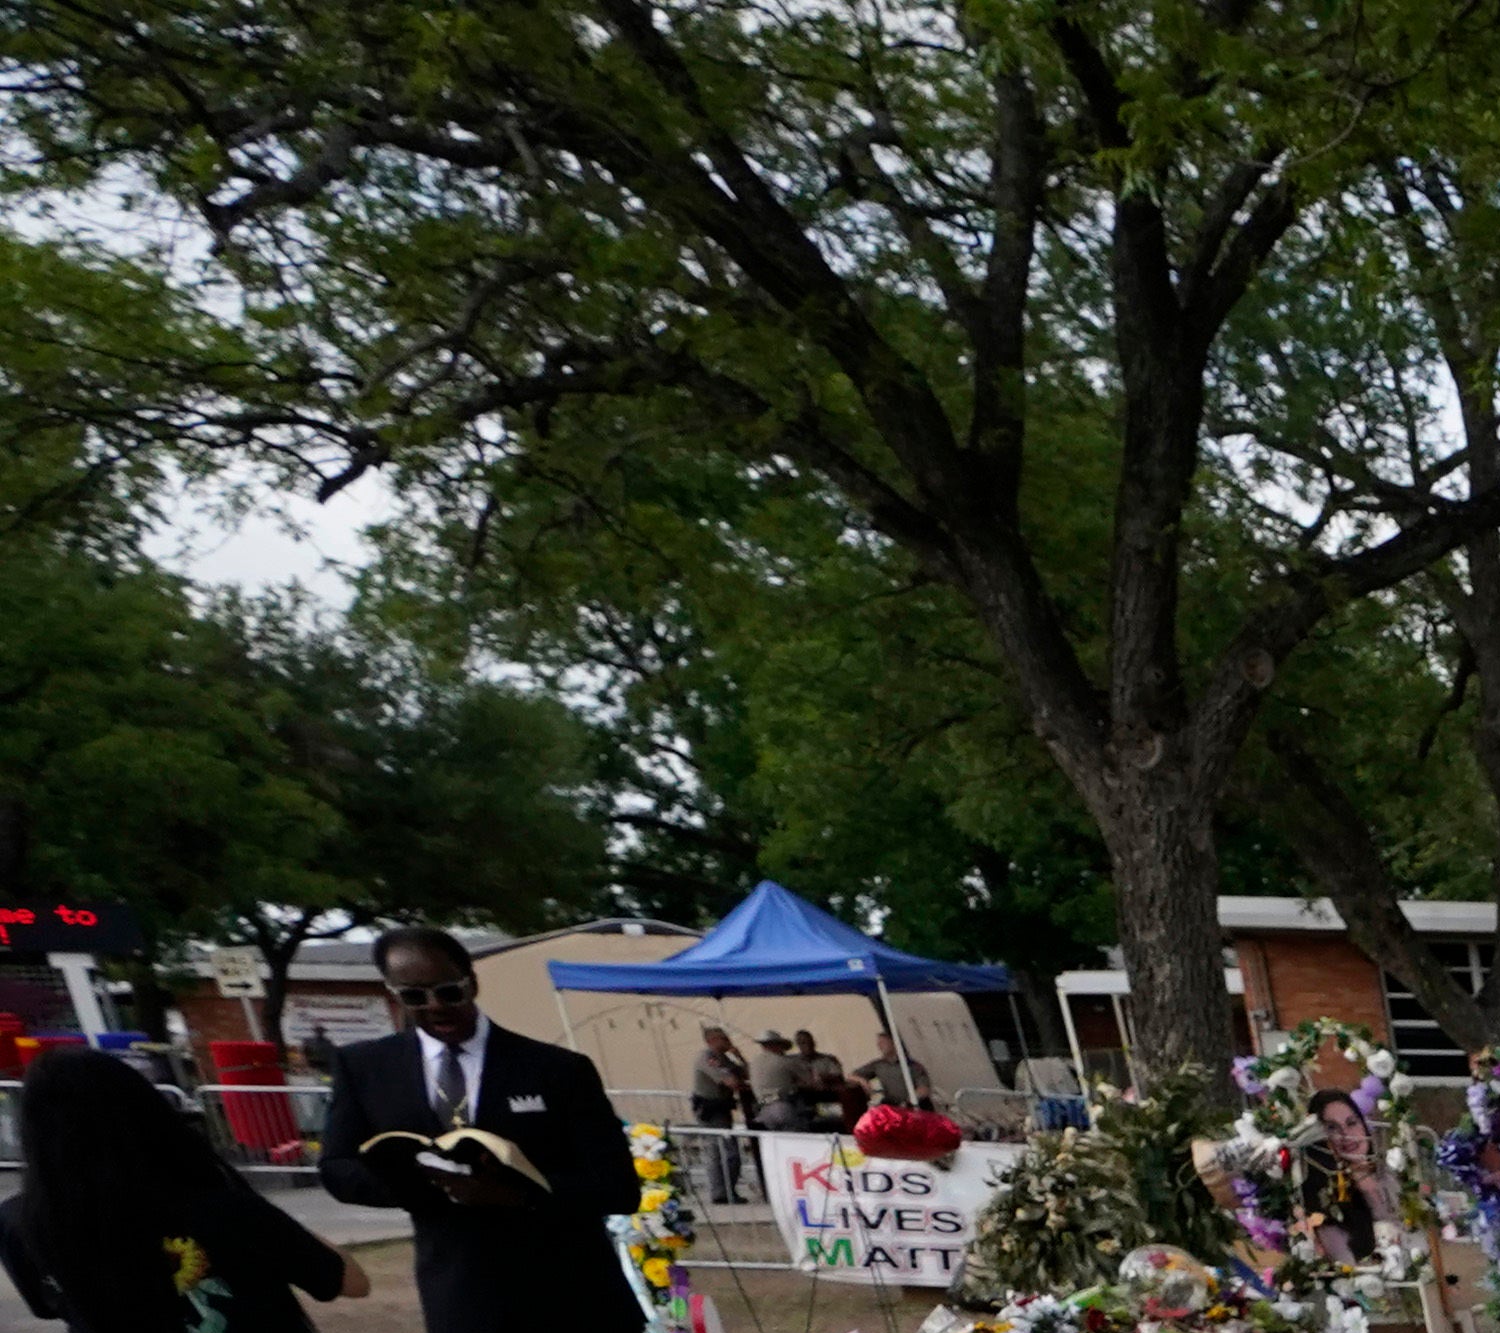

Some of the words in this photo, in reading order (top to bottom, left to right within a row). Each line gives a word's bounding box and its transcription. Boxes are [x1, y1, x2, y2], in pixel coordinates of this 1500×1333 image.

[52, 903, 98, 927] to
[797, 1198, 963, 1233] LIVES
[805, 1237, 961, 1270] MATT
